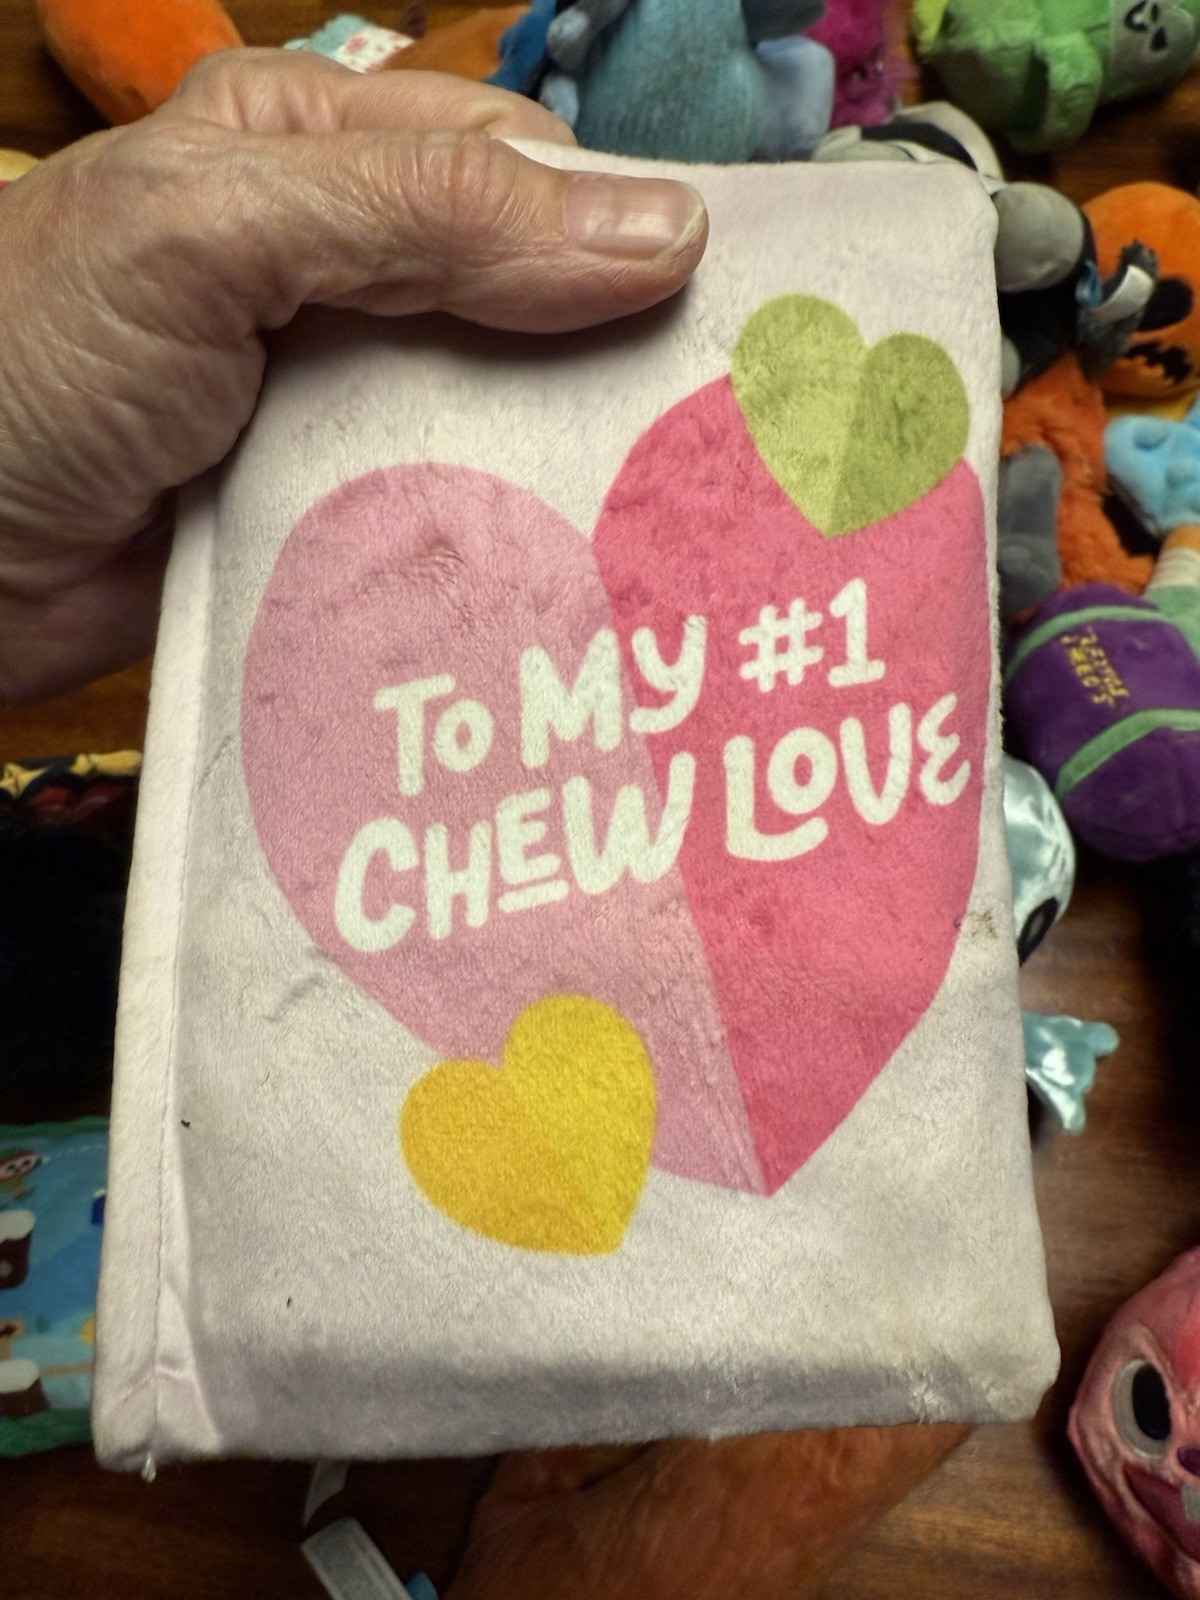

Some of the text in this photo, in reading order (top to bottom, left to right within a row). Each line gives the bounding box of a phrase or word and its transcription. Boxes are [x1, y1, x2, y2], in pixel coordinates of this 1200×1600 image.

[738, 577, 886, 692] #1
[333, 691, 972, 953] CHEW LOVE
